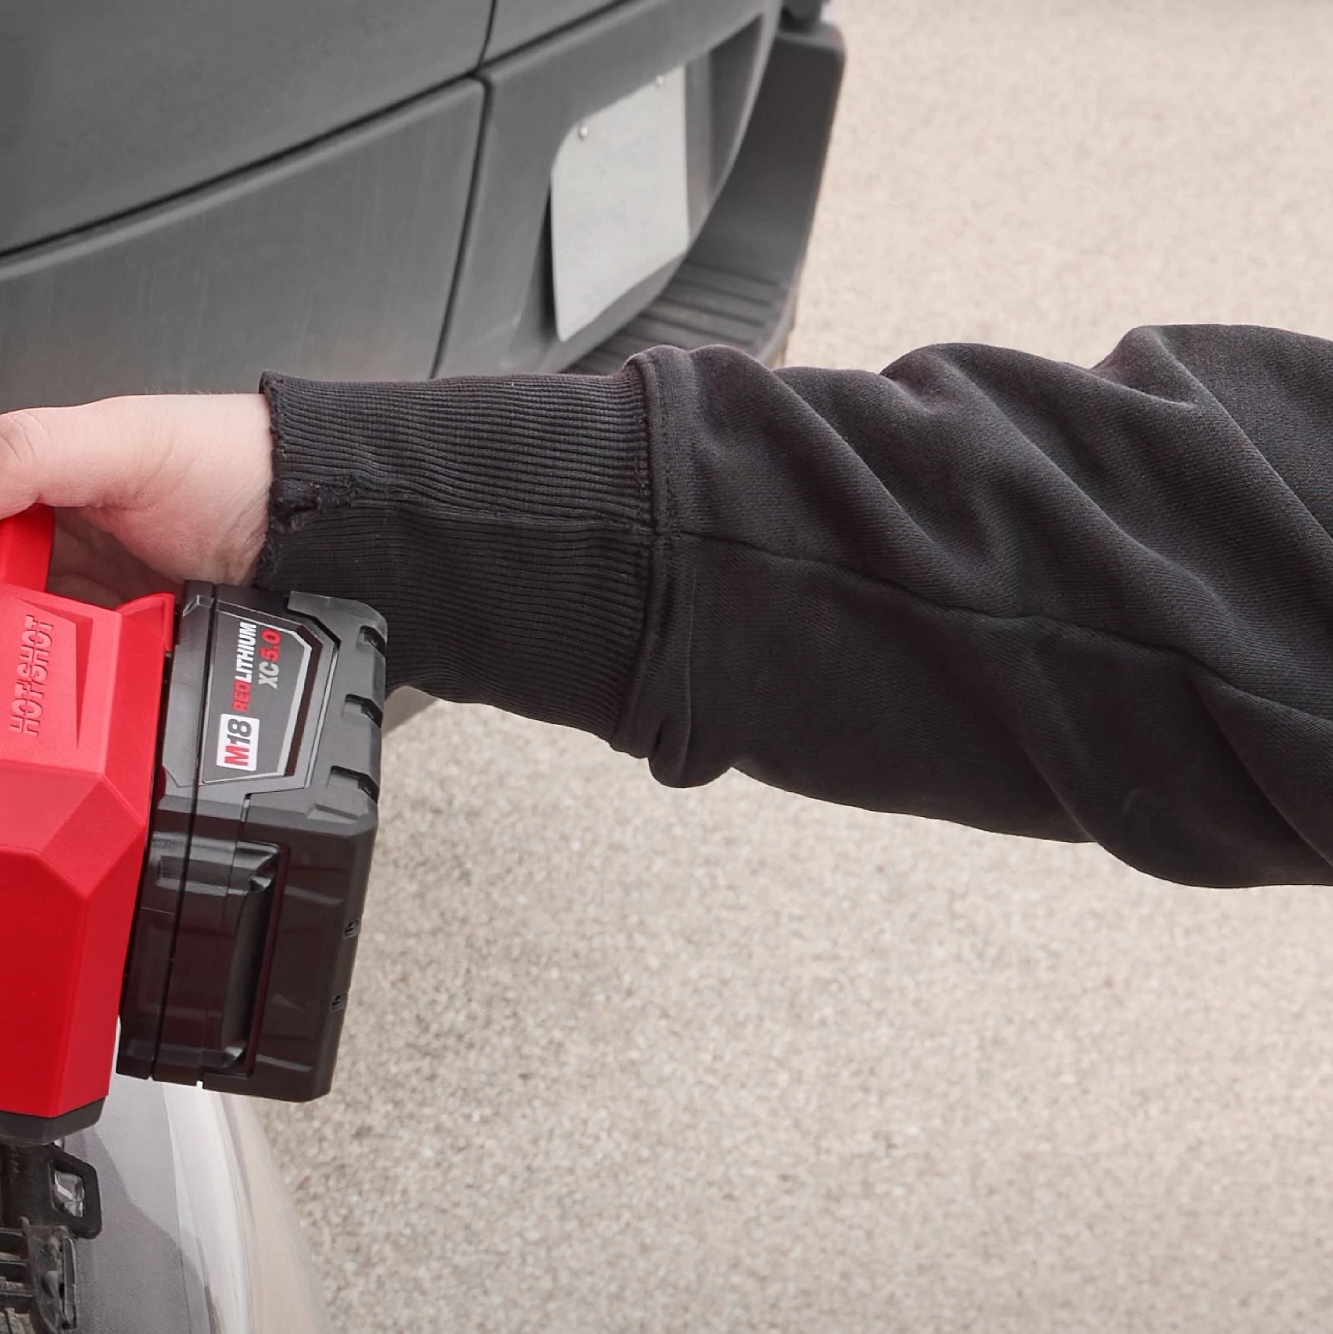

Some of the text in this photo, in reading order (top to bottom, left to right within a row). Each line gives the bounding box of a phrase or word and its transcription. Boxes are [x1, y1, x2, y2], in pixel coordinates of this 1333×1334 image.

[9, 614, 55, 738] HOTSHOT
[233, 621, 258, 713] REDLITHIUM
[223, 718, 254, 767] M18
